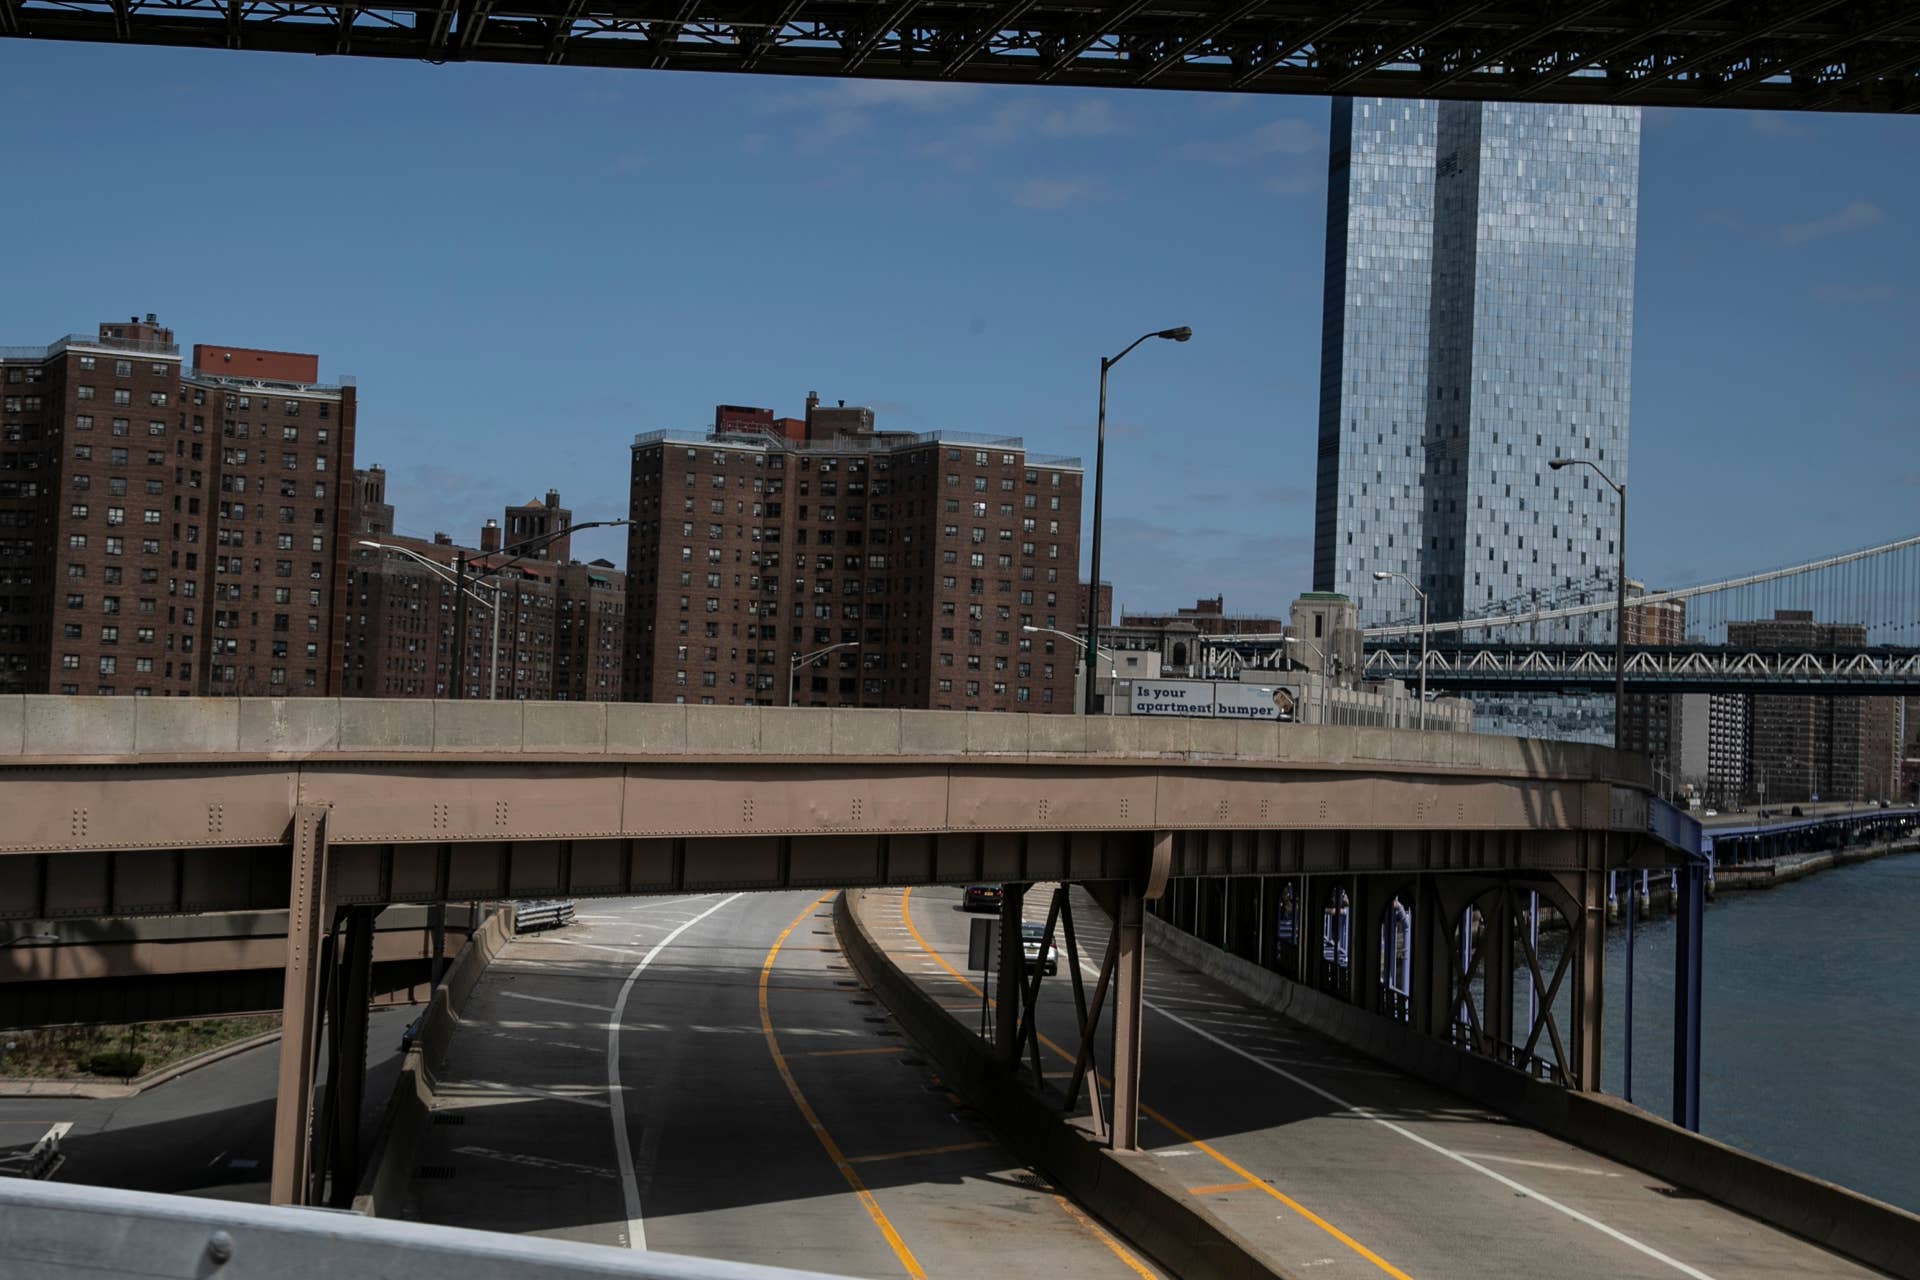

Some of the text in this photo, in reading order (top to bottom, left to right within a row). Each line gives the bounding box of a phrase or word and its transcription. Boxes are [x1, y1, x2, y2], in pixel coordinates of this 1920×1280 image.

[1137, 686, 1186, 699] Is your
[1137, 702, 1274, 716] apartment bumper
